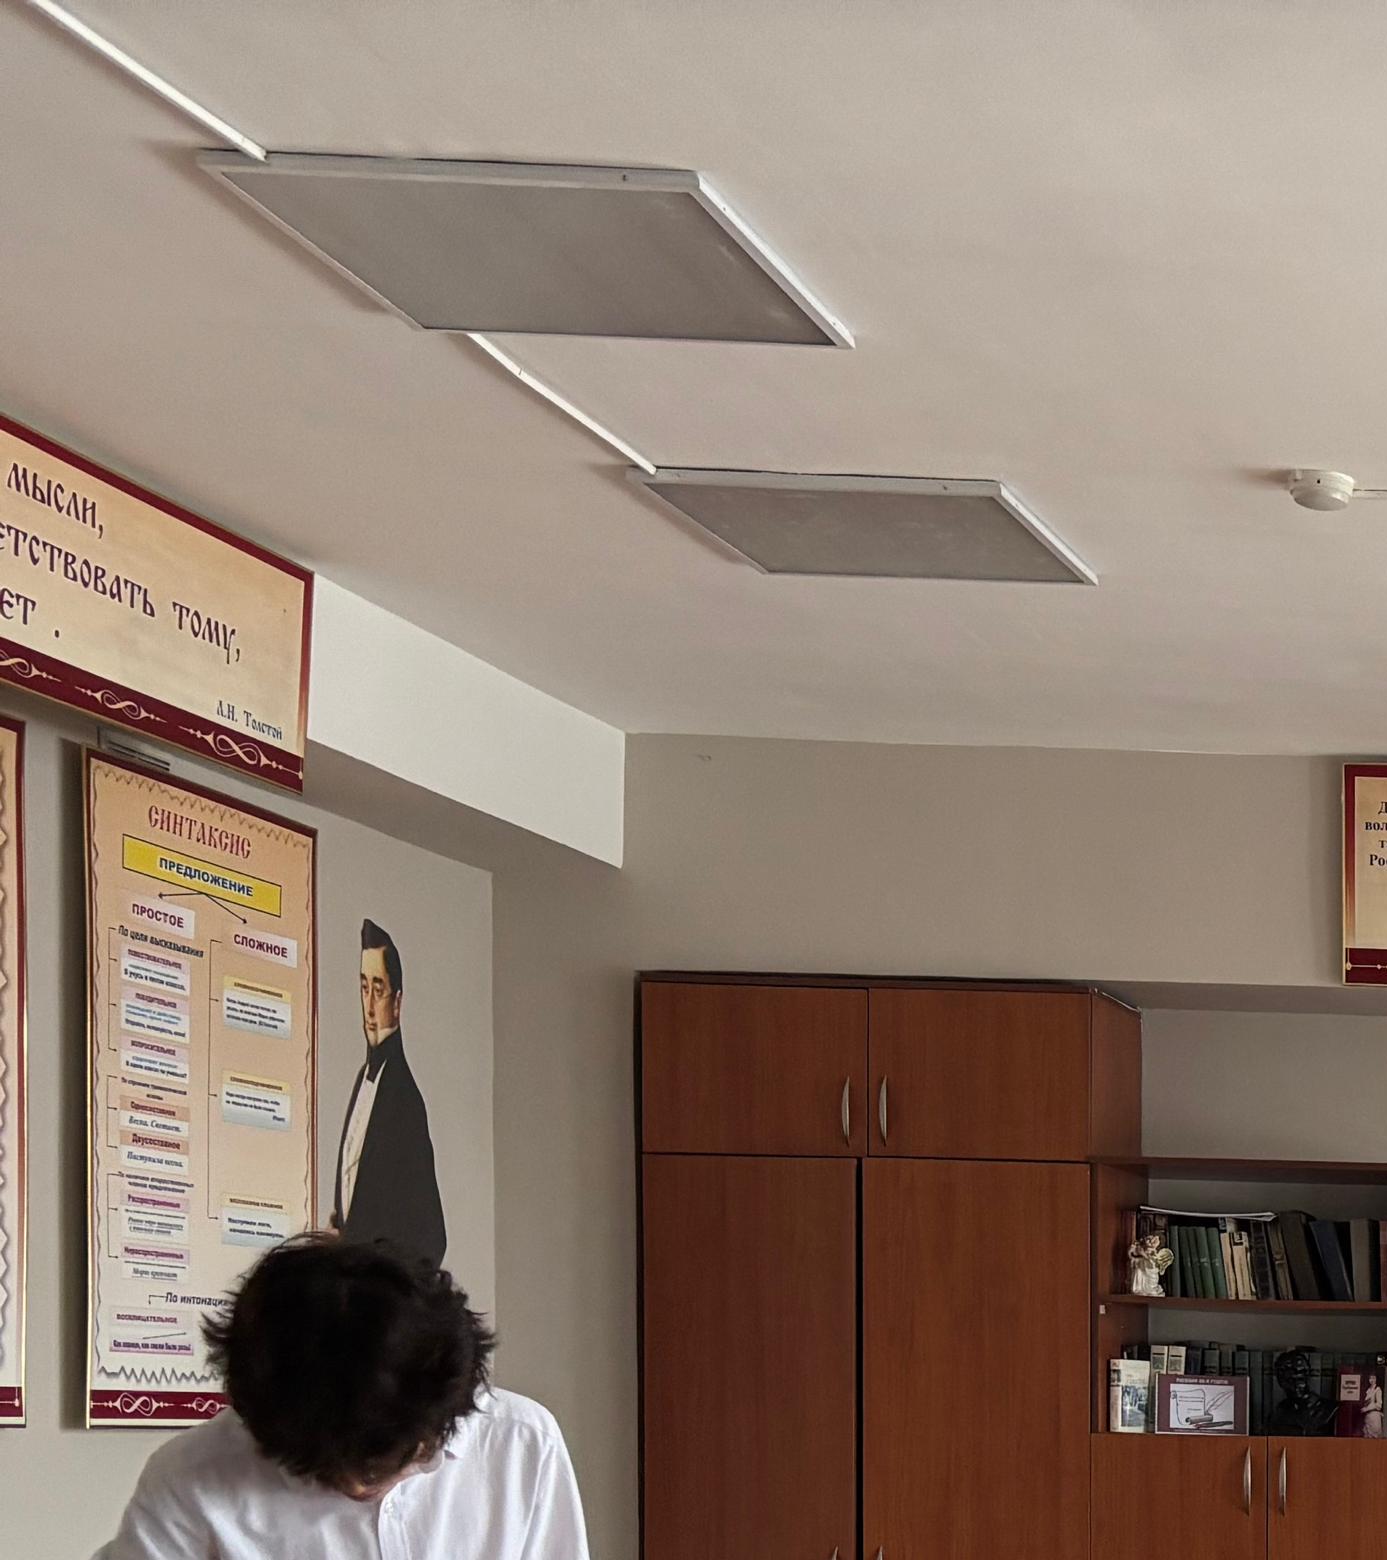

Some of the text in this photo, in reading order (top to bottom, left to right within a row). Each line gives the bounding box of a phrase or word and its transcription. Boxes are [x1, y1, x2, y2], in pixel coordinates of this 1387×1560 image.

[7, 462, 104, 539] мысли,
[173, 600, 241, 664] тому,
[243, 710, 283, 740] Толстой
[148, 804, 251, 859] СИНТАКСИС
[159, 856, 253, 897] ПРЕДЛОЖЕНИЕ
[132, 903, 184, 929] ПРОСТОЕ
[233, 933, 288, 958] СЛОЖНОЕ
[166, 1292, 178, 1303] По
